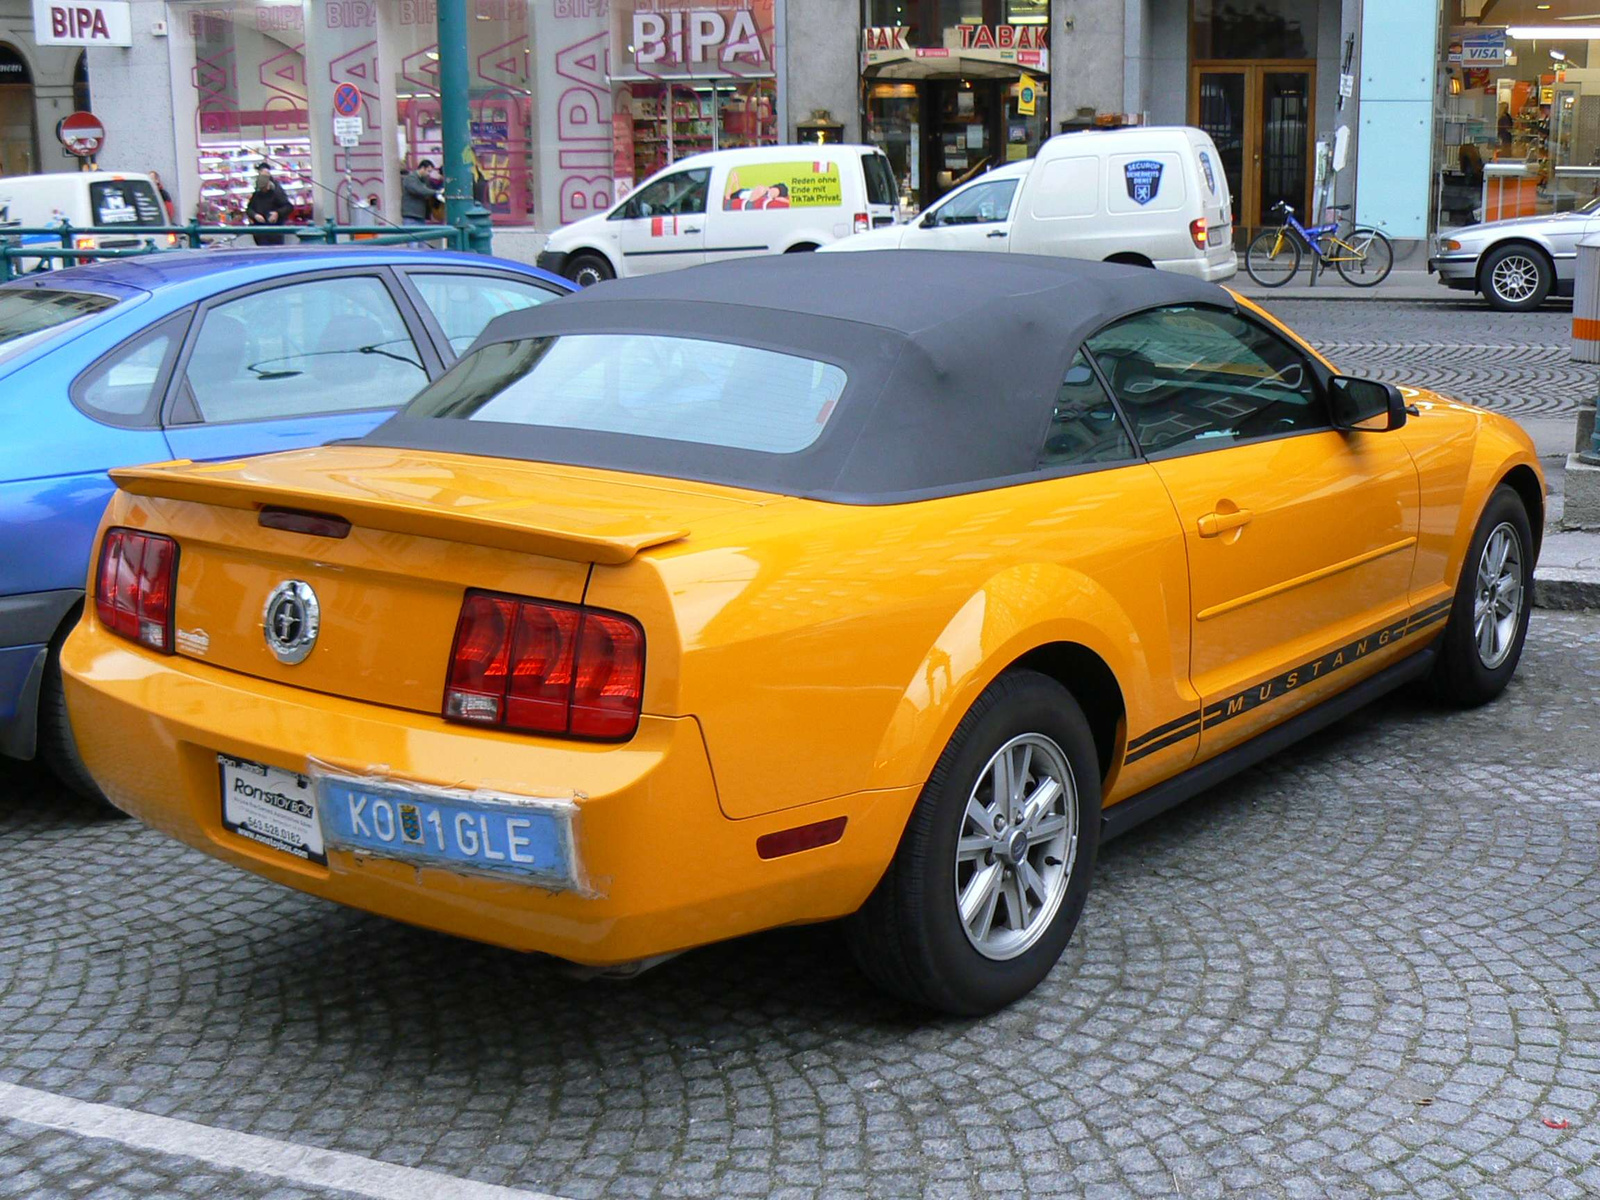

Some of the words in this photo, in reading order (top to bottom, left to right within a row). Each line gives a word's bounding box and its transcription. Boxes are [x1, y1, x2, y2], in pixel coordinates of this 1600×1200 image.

[51, 7, 111, 40] BIPA
[399, 0, 438, 25] BIP
[633, 11, 768, 63] BIPA
[957, 24, 1049, 50] TABAK
[1469, 48, 1499, 59] VISA
[555, 30, 616, 225] BIPA
[791, 177, 815, 185] Reden
[791, 186, 811, 194] Ende
[812, 185, 826, 193] mit
[1226, 629, 1390, 717] MUSTANG
[347, 792, 397, 843] KO
[425, 807, 446, 852] 1
[453, 811, 536, 865] GLE
